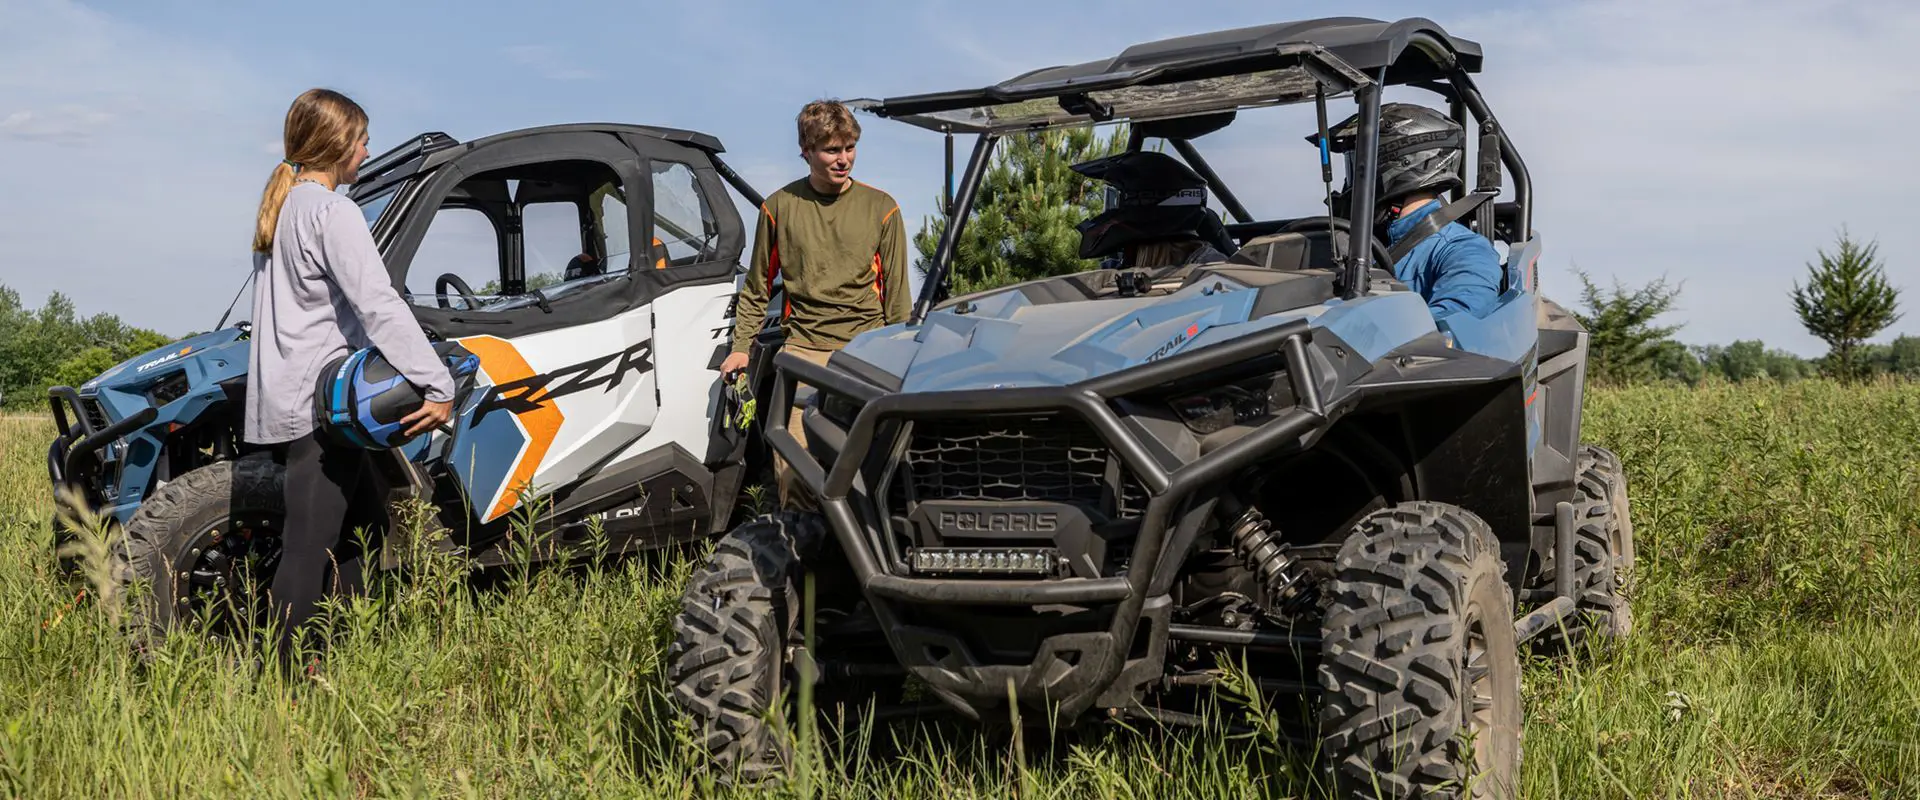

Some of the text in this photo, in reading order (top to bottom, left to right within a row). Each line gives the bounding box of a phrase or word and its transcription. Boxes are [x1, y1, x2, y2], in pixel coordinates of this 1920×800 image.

[1145, 333, 1187, 363] TRAIL
[136, 352, 178, 373] TRAIL
[469, 338, 654, 430] RZR
[939, 511, 1058, 532] POLARIS
